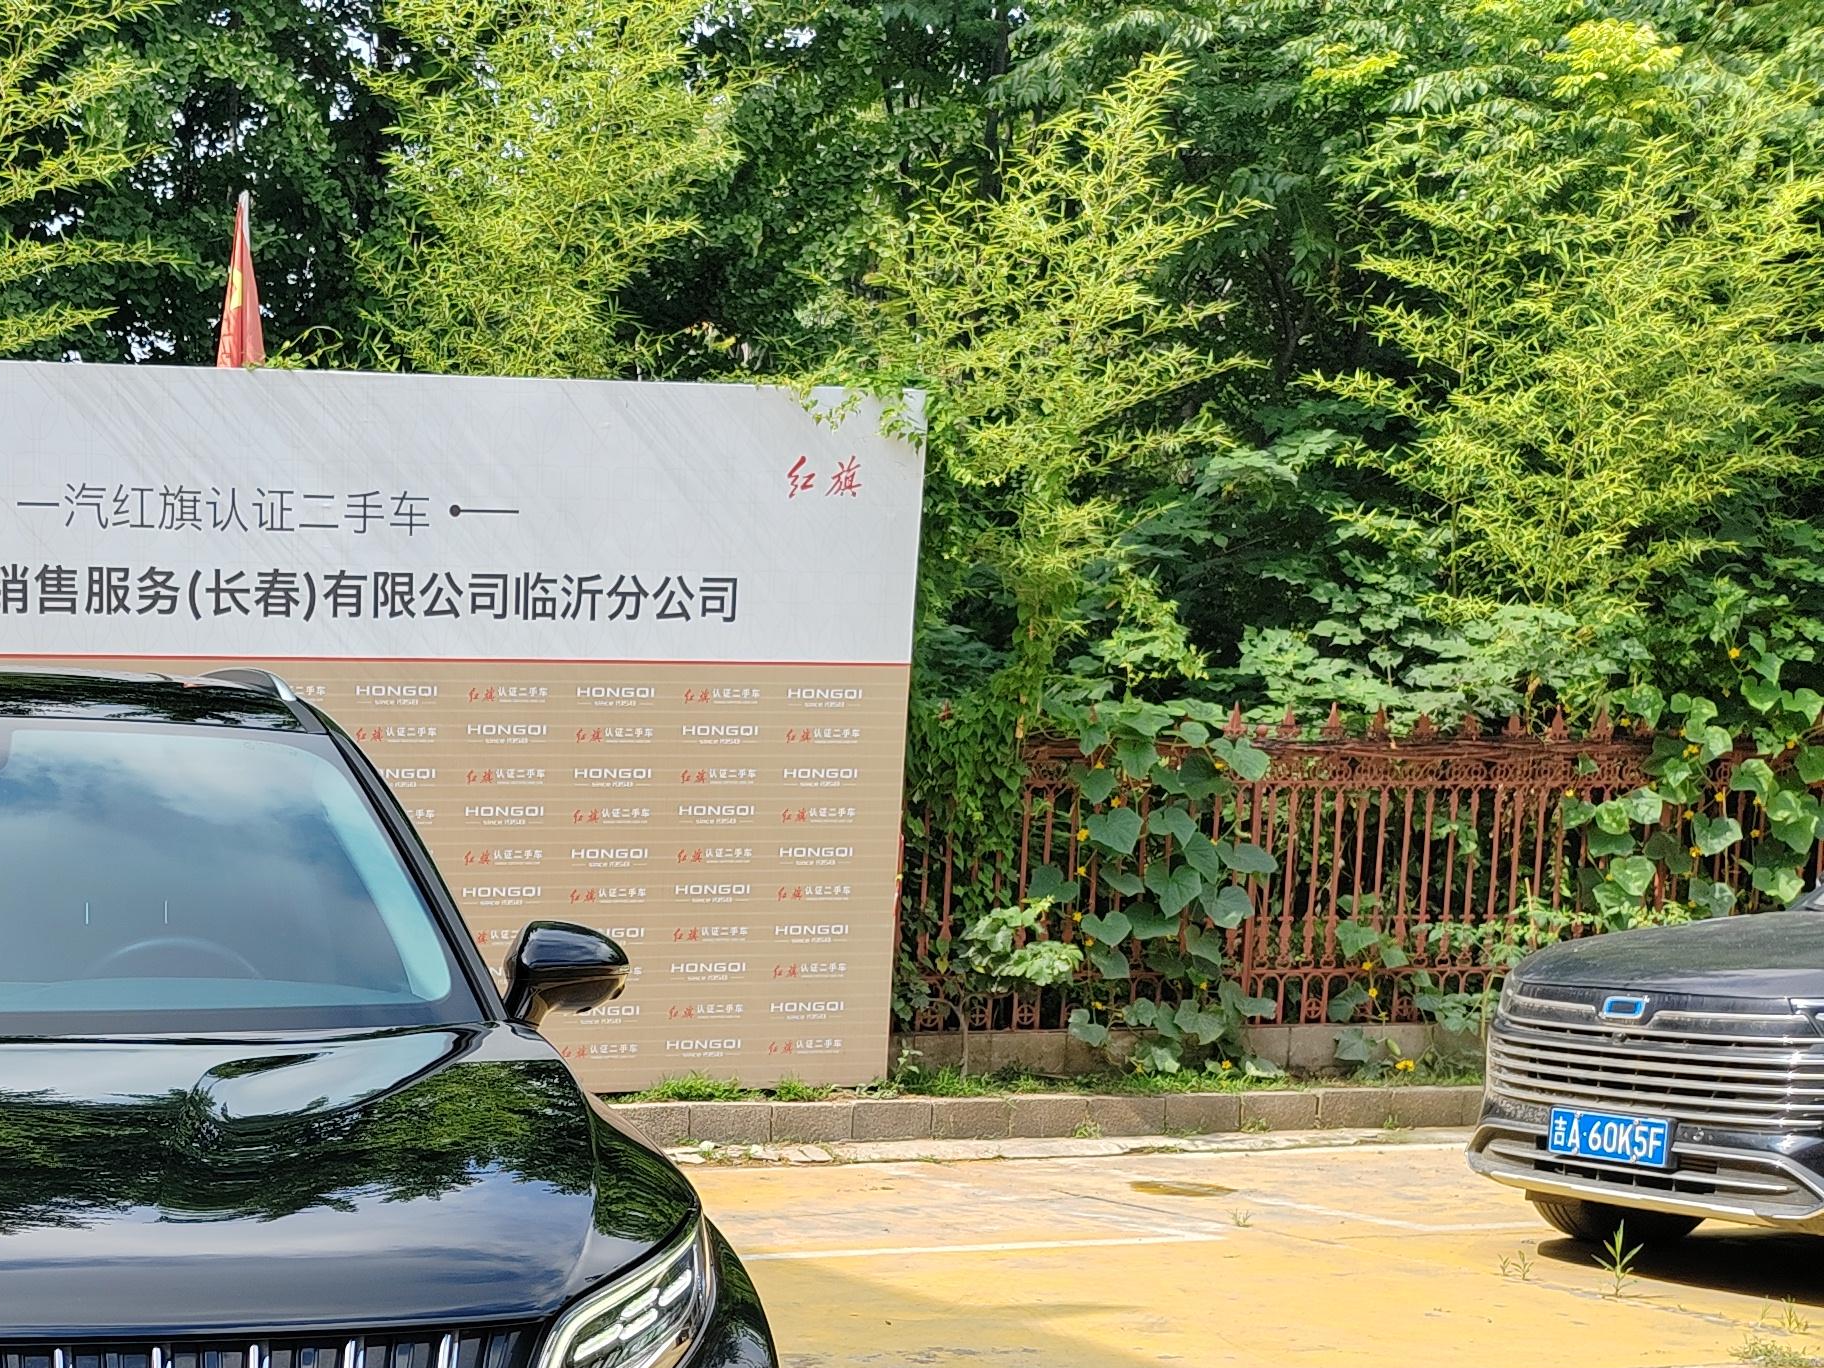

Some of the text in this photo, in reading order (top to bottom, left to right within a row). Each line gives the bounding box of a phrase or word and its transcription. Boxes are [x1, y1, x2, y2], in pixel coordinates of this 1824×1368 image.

[786, 454, 863, 500] 红旗
[16, 481, 430, 537] 一汽红旗认证二手车
[356, 685, 438, 698] HONGQI
[577, 686, 655, 699] HONGQI
[788, 688, 862, 701] HONGQI
[467, 724, 547, 737] HONGQI
[682, 725, 758, 738] HONGQI
[574, 768, 652, 781] HONGQI
[784, 768, 858, 781] HONGQI
[465, 806, 544, 819] HONGQI
[678, 805, 754, 818] HONGQI
[572, 848, 648, 861] HONGQI
[779, 846, 853, 859] HONGQI
[462, 886, 541, 899] HONGQI
[675, 884, 750, 897] HONGQI
[606, 927, 645, 938] GQI
[775, 924, 849, 937] HONGQI
[671, 962, 746, 975] HONGQI
[770, 1001, 844, 1014] HONGQI
[666, 1039, 741, 1052] HONGQI
